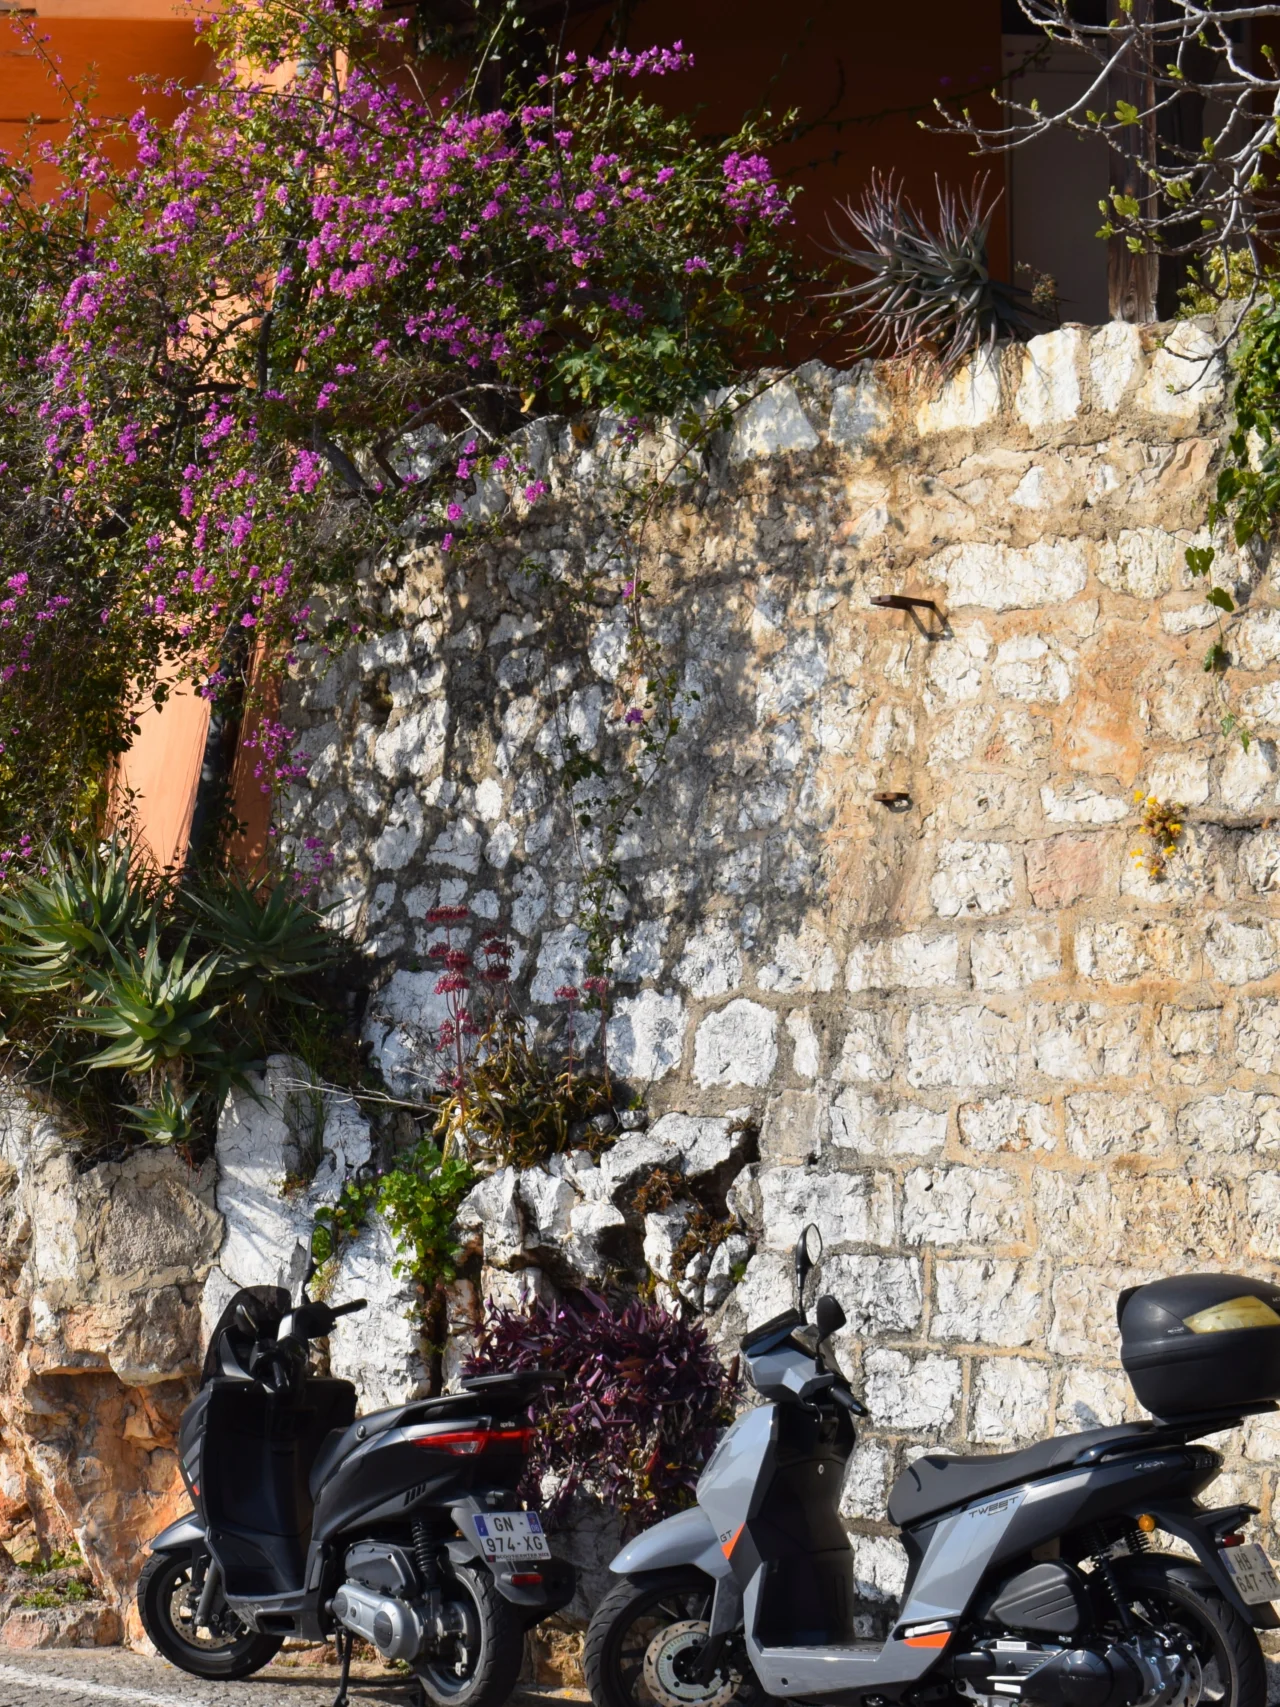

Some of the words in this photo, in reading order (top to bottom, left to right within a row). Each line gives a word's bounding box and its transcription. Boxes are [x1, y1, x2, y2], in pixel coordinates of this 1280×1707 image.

[500, 1421, 516, 1429] aprilia
[968, 1496, 1019, 1519] TWEET
[720, 1530, 732, 1543] GT
[486, 1536, 543, 1553] 974-XG
